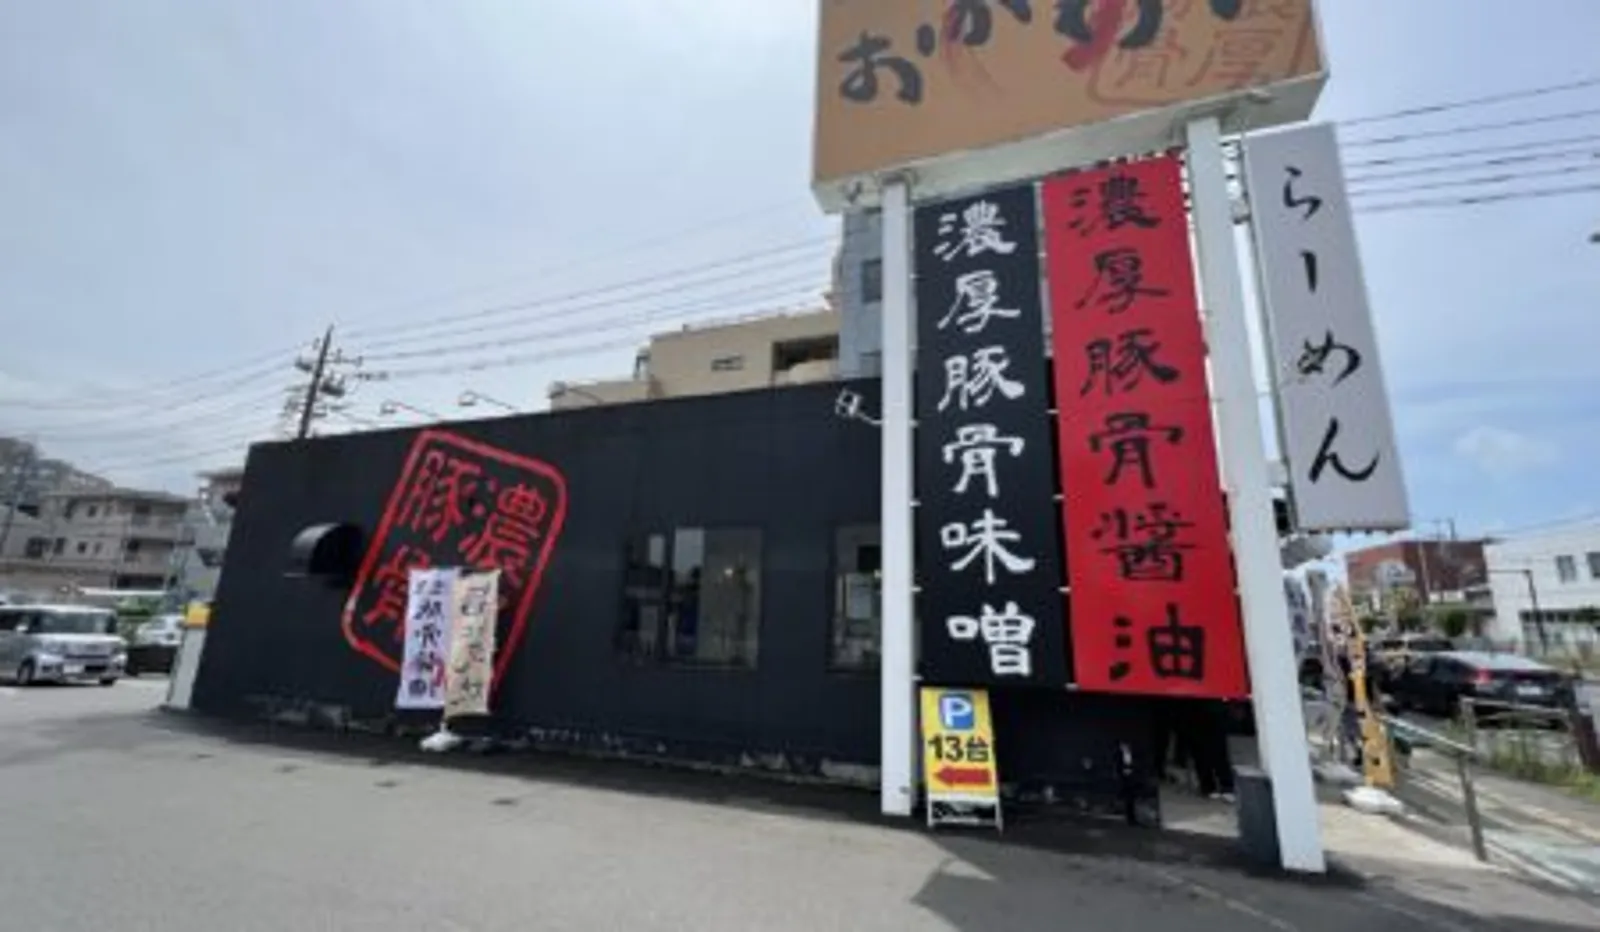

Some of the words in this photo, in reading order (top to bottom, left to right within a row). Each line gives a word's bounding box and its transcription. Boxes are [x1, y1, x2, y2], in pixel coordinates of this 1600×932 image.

[933, 199, 1035, 678] 濃厚豚骨味噌
[1283, 165, 1380, 484] らーめん
[927, 734, 990, 764] 13台
